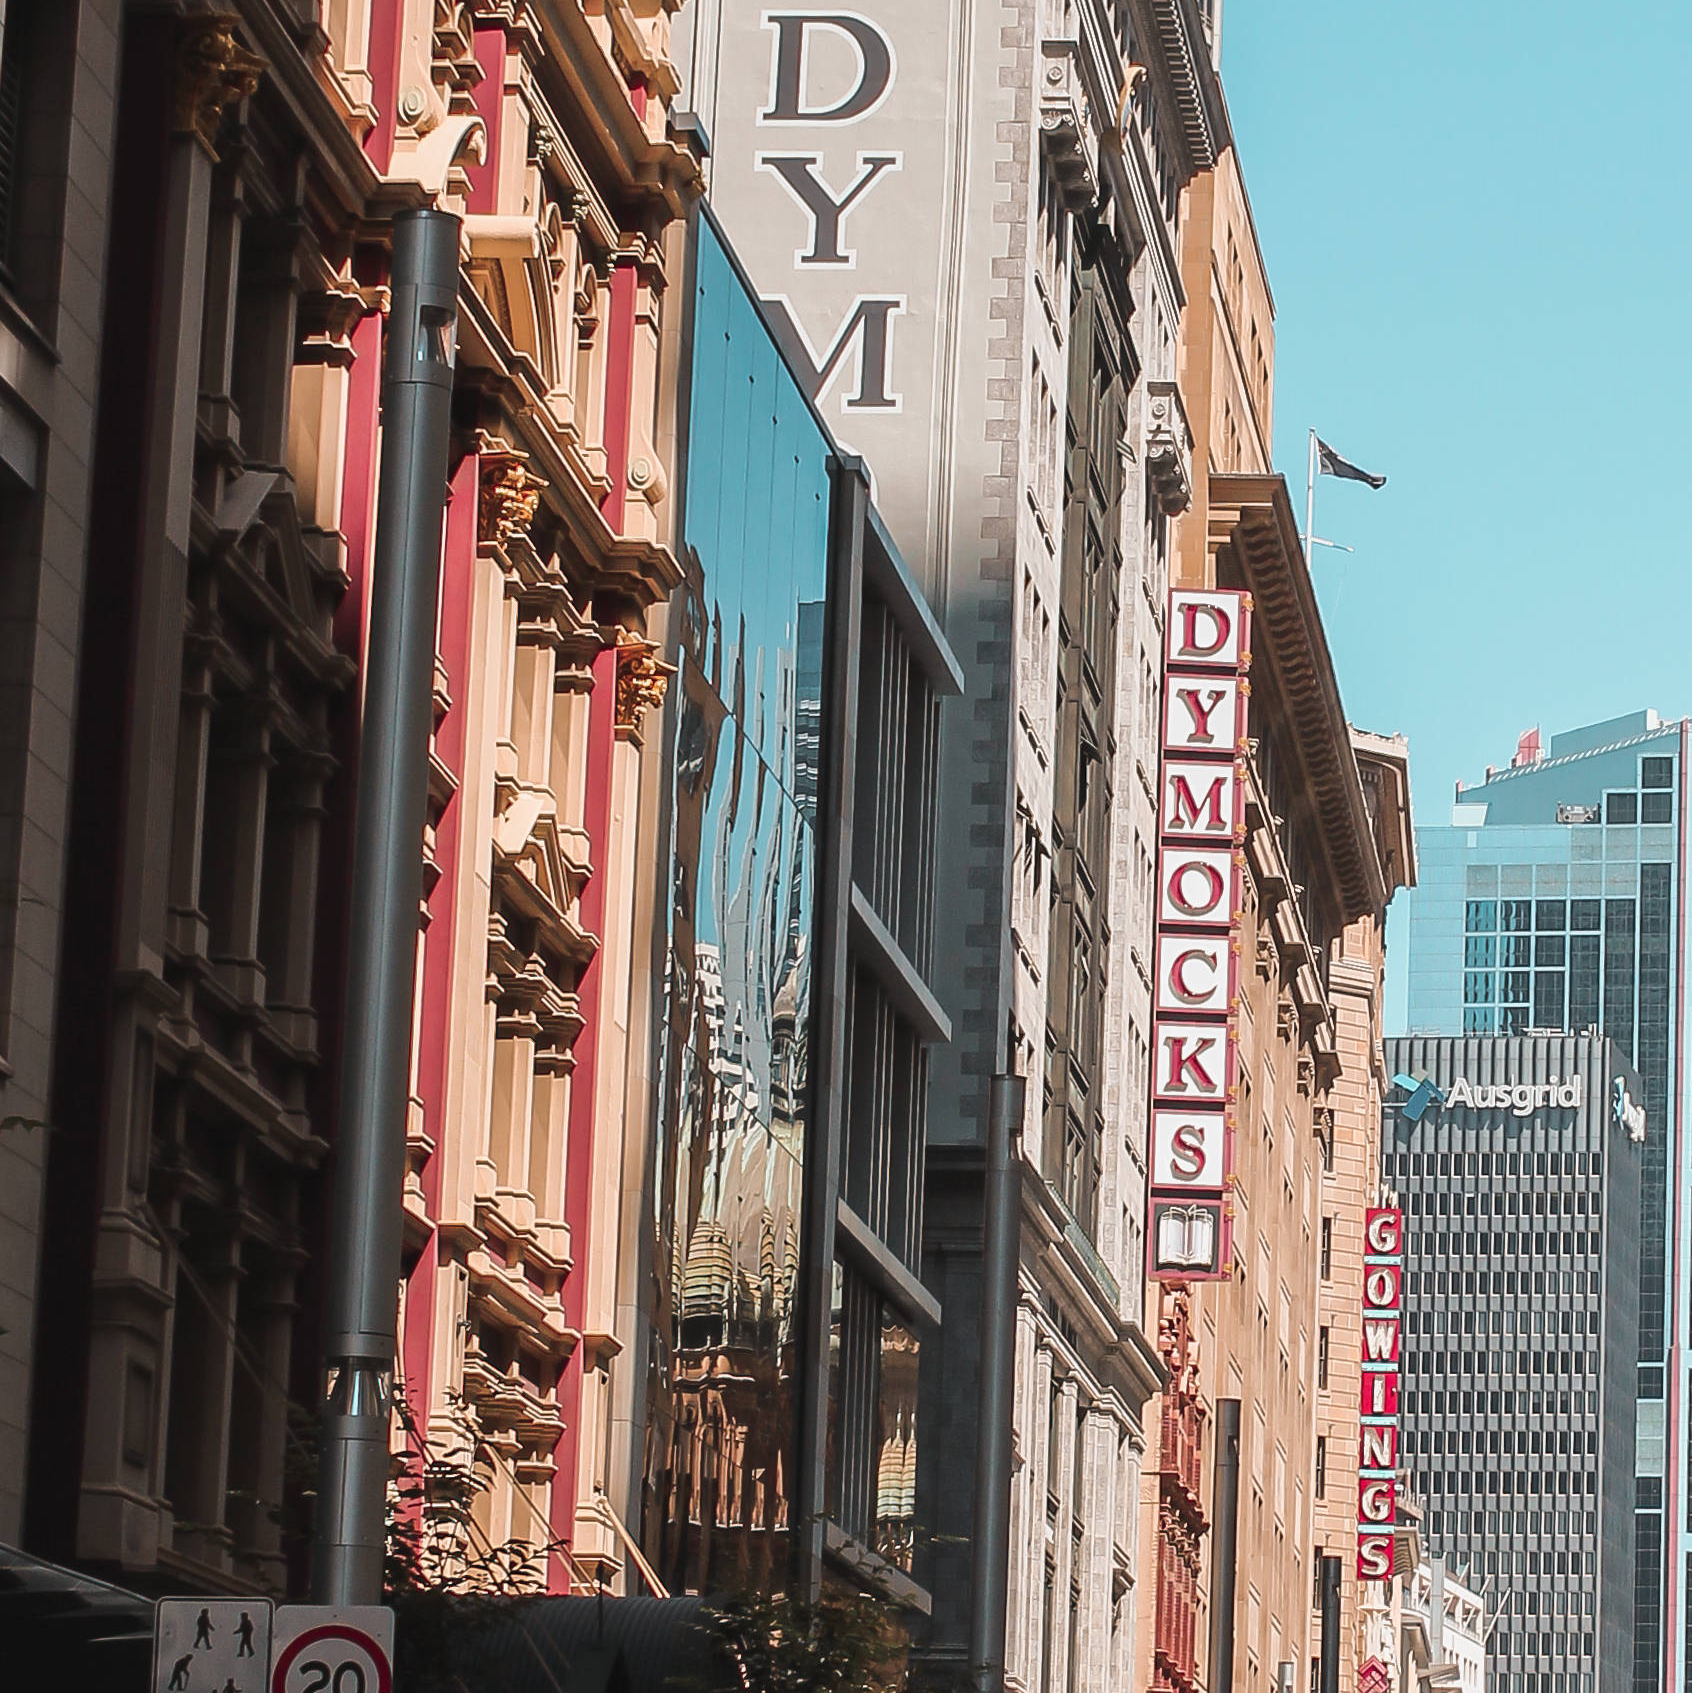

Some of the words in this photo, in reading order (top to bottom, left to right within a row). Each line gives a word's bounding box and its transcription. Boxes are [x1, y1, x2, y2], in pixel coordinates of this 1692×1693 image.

[755, 10, 907, 458] DYM
[1163, 601, 1231, 1182] DYMOCKS
[1445, 1074, 1581, 1116] Ausgrid
[1361, 1212, 1397, 1578] GOWINGS
